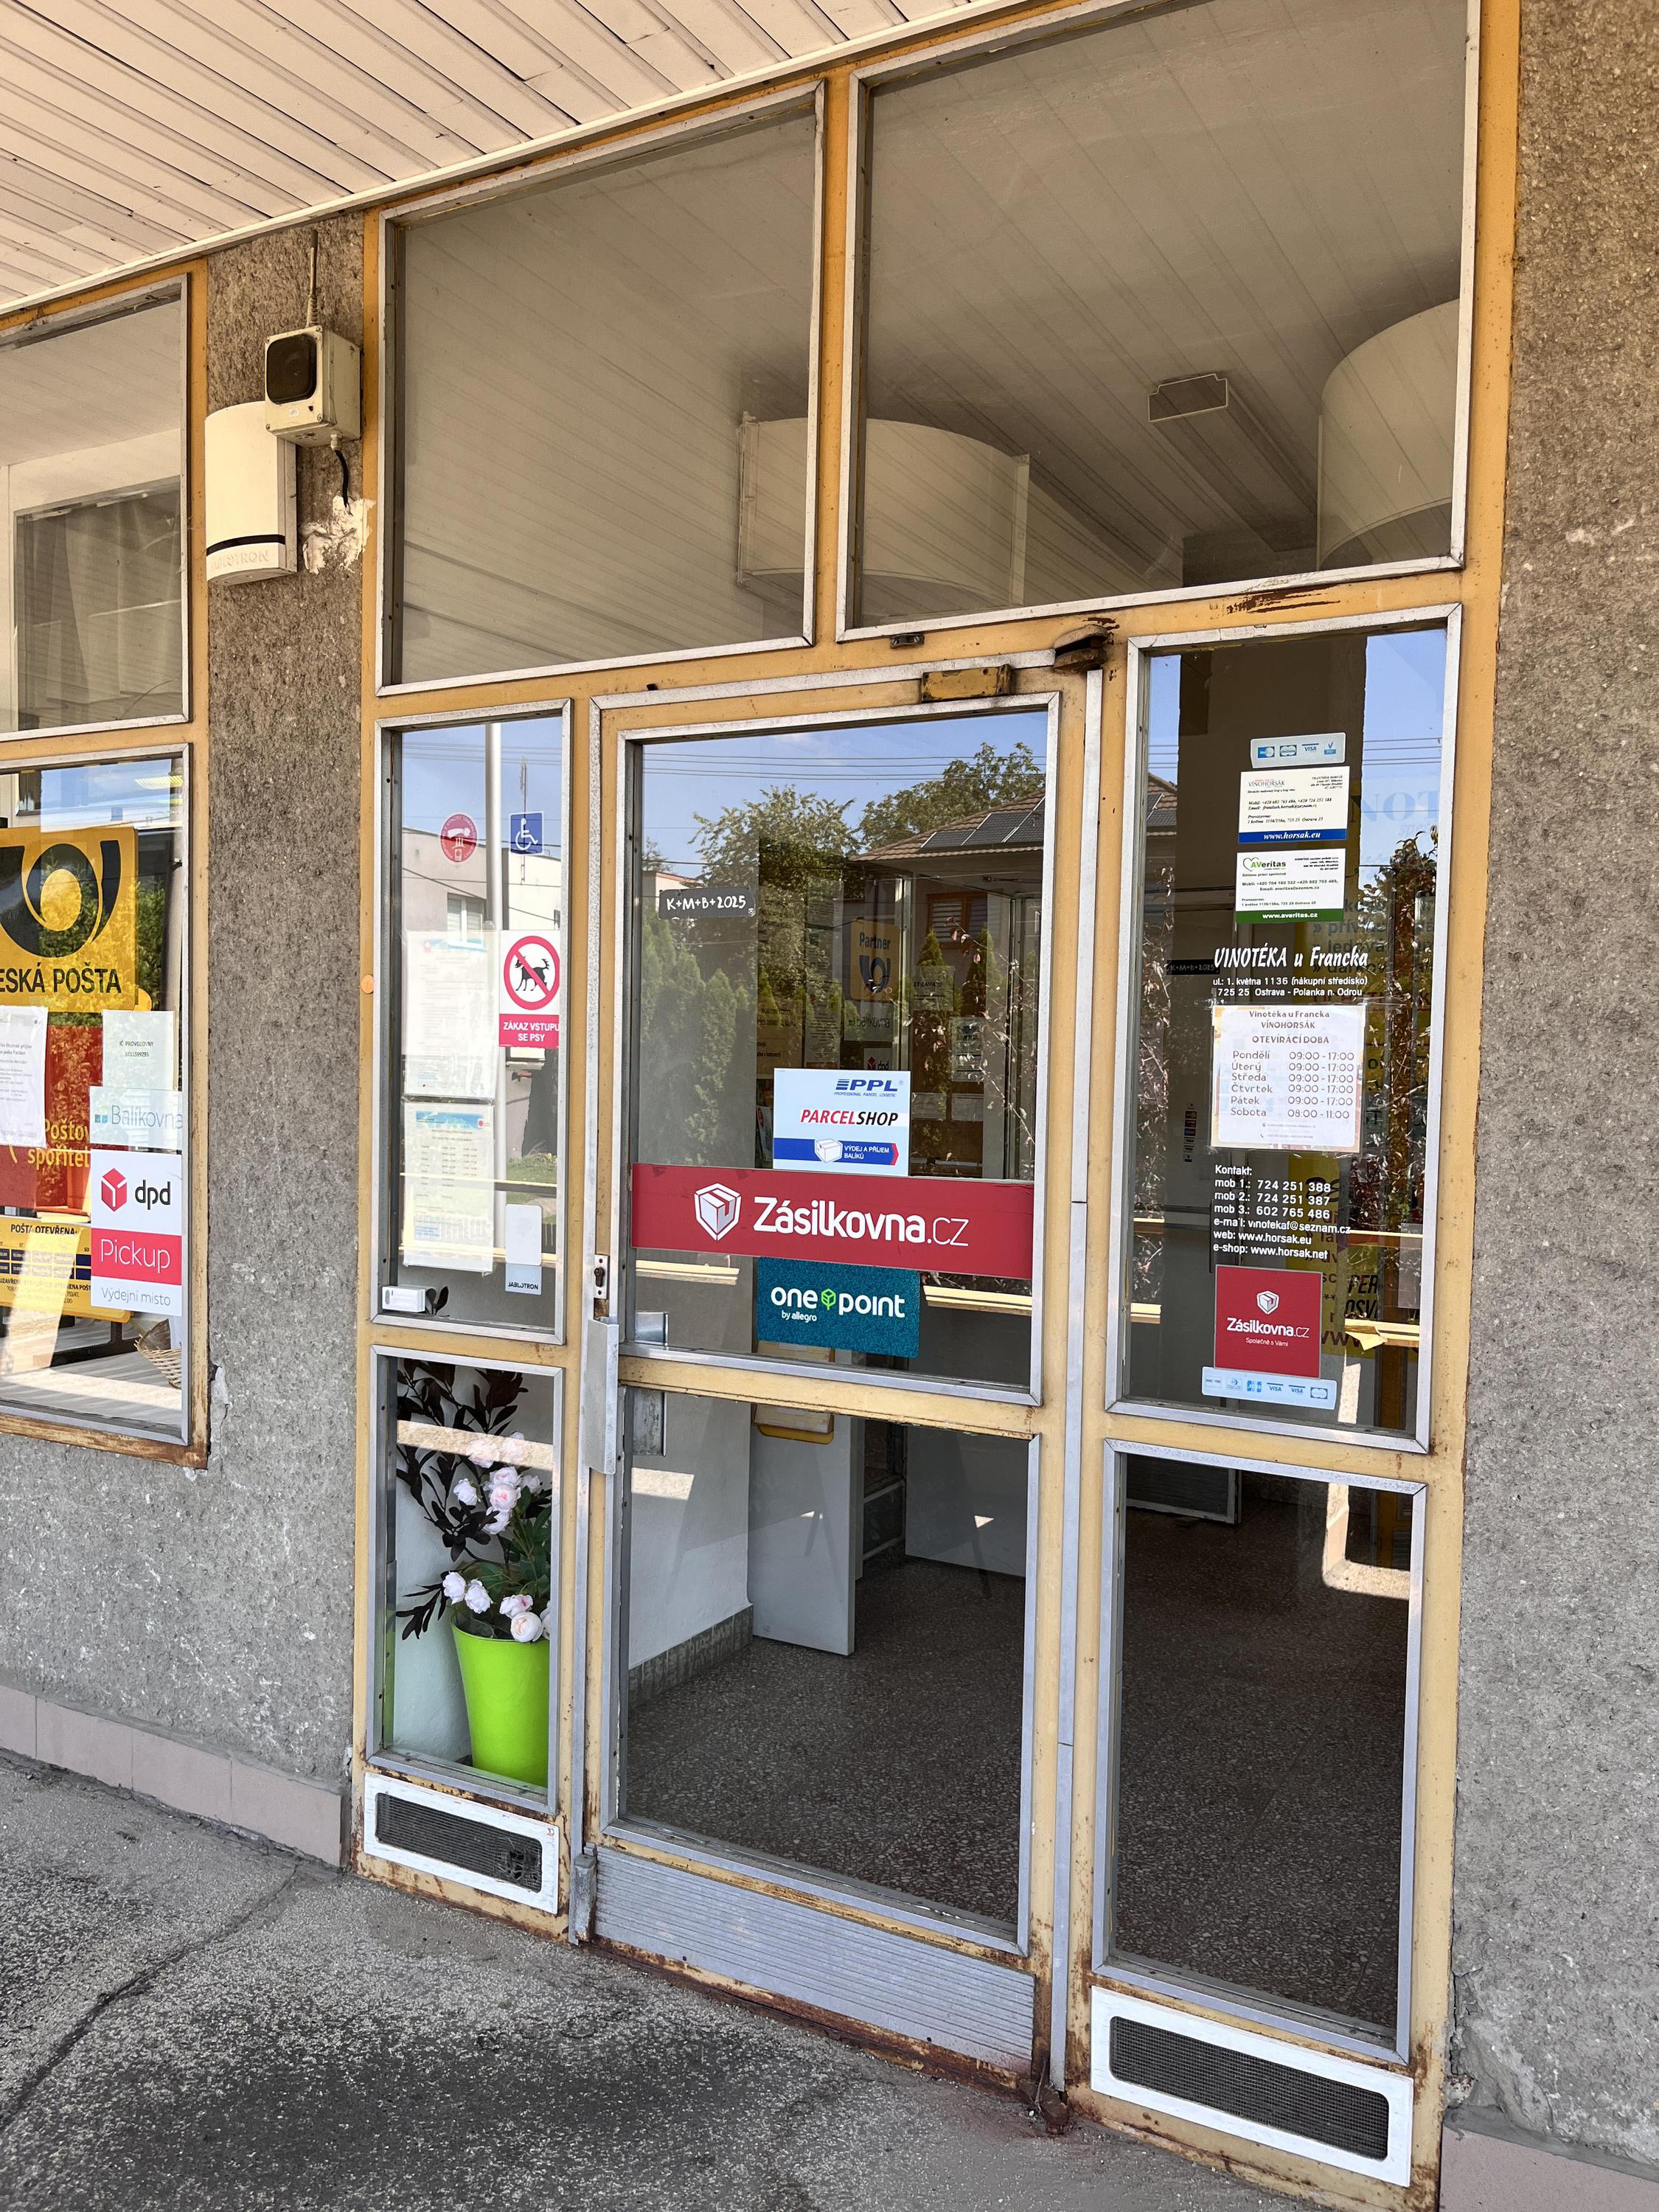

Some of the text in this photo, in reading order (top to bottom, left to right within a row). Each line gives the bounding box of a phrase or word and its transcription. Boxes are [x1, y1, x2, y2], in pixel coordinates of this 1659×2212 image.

[1264, 831, 1321, 840] www.horsak.eu
[667, 895, 746, 911] K+M+B+2025
[859, 931, 891, 950] Partner
[1214, 942, 1287, 968] VINOTÉKA
[1294, 952, 1304, 967] u
[1310, 945, 1368, 968] Francka
[53, 961, 122, 993] POŠTA
[1213, 977, 1224, 985] ul.:
[1237, 977, 1262, 985] května
[1265, 977, 1288, 985] 1136
[1291, 976, 1326, 987] (nákupní
[1327, 976, 1368, 986] středisko)
[1218, 988, 1235, 996] 725
[1238, 988, 1250, 996] 25
[1255, 988, 1285, 996] Ostrava
[1293, 988, 1325, 996] Polanka
[1337, 988, 1363, 996] Odrou
[503, 1020, 560, 1032] ZÁKAZ VSTUPU
[518, 1033, 545, 1042] SE PSY
[1304, 1036, 1329, 1044] DOBA
[1233, 1051, 1270, 1060] Pondělí
[1289, 1051, 1320, 1060] 09:00
[1328, 1051, 1354, 1060] 17:00
[1231, 1060, 1262, 1073] Úterý
[1289, 1062, 1319, 1071] 09:00
[1327, 1062, 1354, 1072] 17:00
[1231, 1072, 1267, 1082] Středa
[1289, 1074, 1319, 1082] 09:00
[1327, 1074, 1354, 1083] 17:00
[849, 1079, 898, 1092] PPL
[1231, 1082, 1273, 1093] Čtvrtek
[1288, 1084, 1319, 1093] 09:00
[1326, 1085, 1354, 1094] 17:00
[1231, 1096, 1260, 1105] Pátek
[1288, 1096, 1318, 1105] 09:00
[1326, 1096, 1353, 1106] 17:00
[111, 1105, 183, 1129] Balíkovna
[801, 1109, 899, 1126] PARCELSHOP
[1231, 1107, 1267, 1116] Sobota
[1287, 1109, 1318, 1118] 08:00
[1326, 1110, 1350, 1119] 11:00
[844, 1144, 863, 1152] VÝDEJ
[869, 1145, 890, 1153] PŘÍJEM
[844, 1152, 864, 1160] BALÍKŮ
[1215, 1164, 1253, 1175] Kontakt:
[1215, 1179, 1332, 1193] mob 1.: 724 251 388
[135, 1179, 170, 1210] dpd
[1214, 1192, 1330, 1206] mob 2.: 724 251 387
[1214, 1204, 1330, 1220] mob 3.: 602 765 486
[1248, 1220, 1351, 1234] vinotekaf@seznam.cz
[1213, 1231, 1312, 1245] web: www.horsak.eu
[101, 1238, 171, 1274] Pickup
[1213, 1243, 1328, 1260] e-shop: www.horsak.net
[508, 1282, 539, 1290] JABLOTRON
[101, 1287, 171, 1306] Výdejní místo
[771, 1286, 905, 1318] one point
[782, 1310, 818, 1324] by allegro
[1245, 1337, 1270, 1346] Společně
[1275, 1338, 1289, 1346] Vámi
